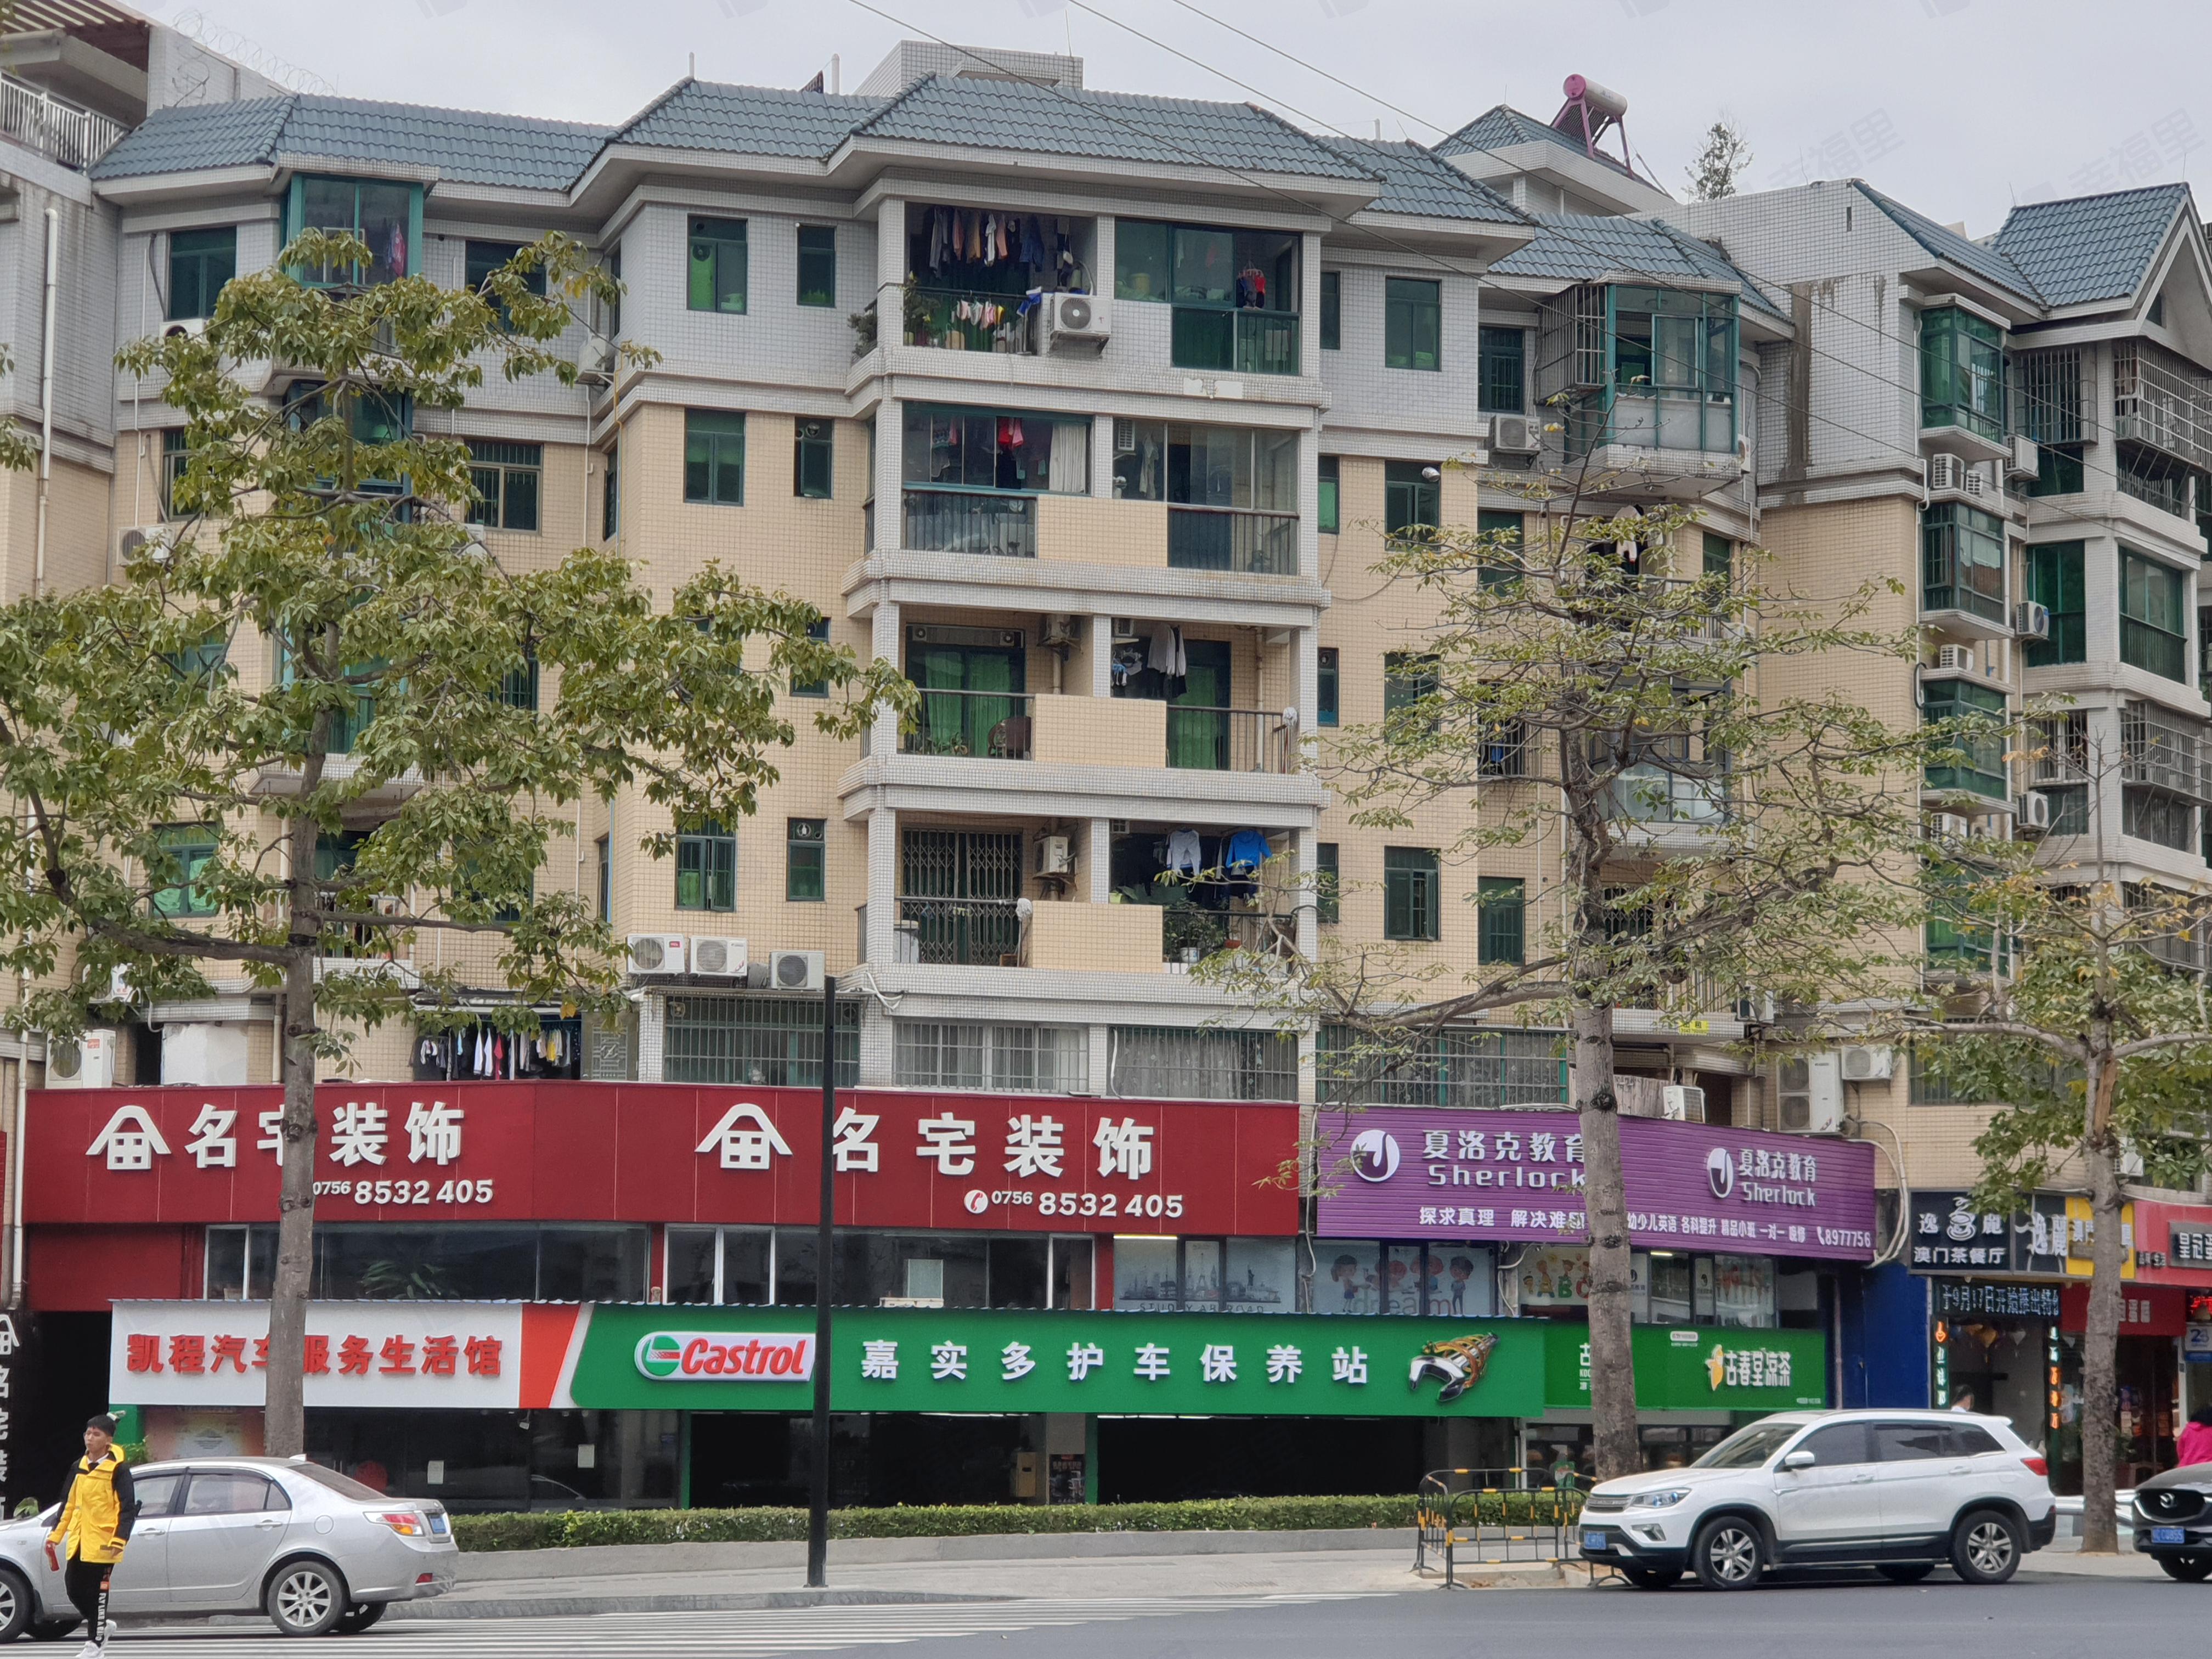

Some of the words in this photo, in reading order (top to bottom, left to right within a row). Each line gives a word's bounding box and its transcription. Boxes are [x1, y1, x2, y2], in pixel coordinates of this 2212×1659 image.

[832, 1107, 1154, 1180] 名宅装饰
[1422, 1130, 1585, 1163] 夏洛克教育
[1738, 1148, 1818, 1183] 夏洛克教育
[313, 1181, 352, 1196] 0756
[991, 1191, 1033, 1205] 0756
[1742, 1182, 1816, 1207] Sherlock
[1419, 1207, 1495, 1226] 探求真理
[1914, 1246, 2006, 1264] 澳门茶餐厅
[681, 1338, 808, 1375] Castrol
[861, 1339, 1368, 1384] 嘉实多护车保养站
